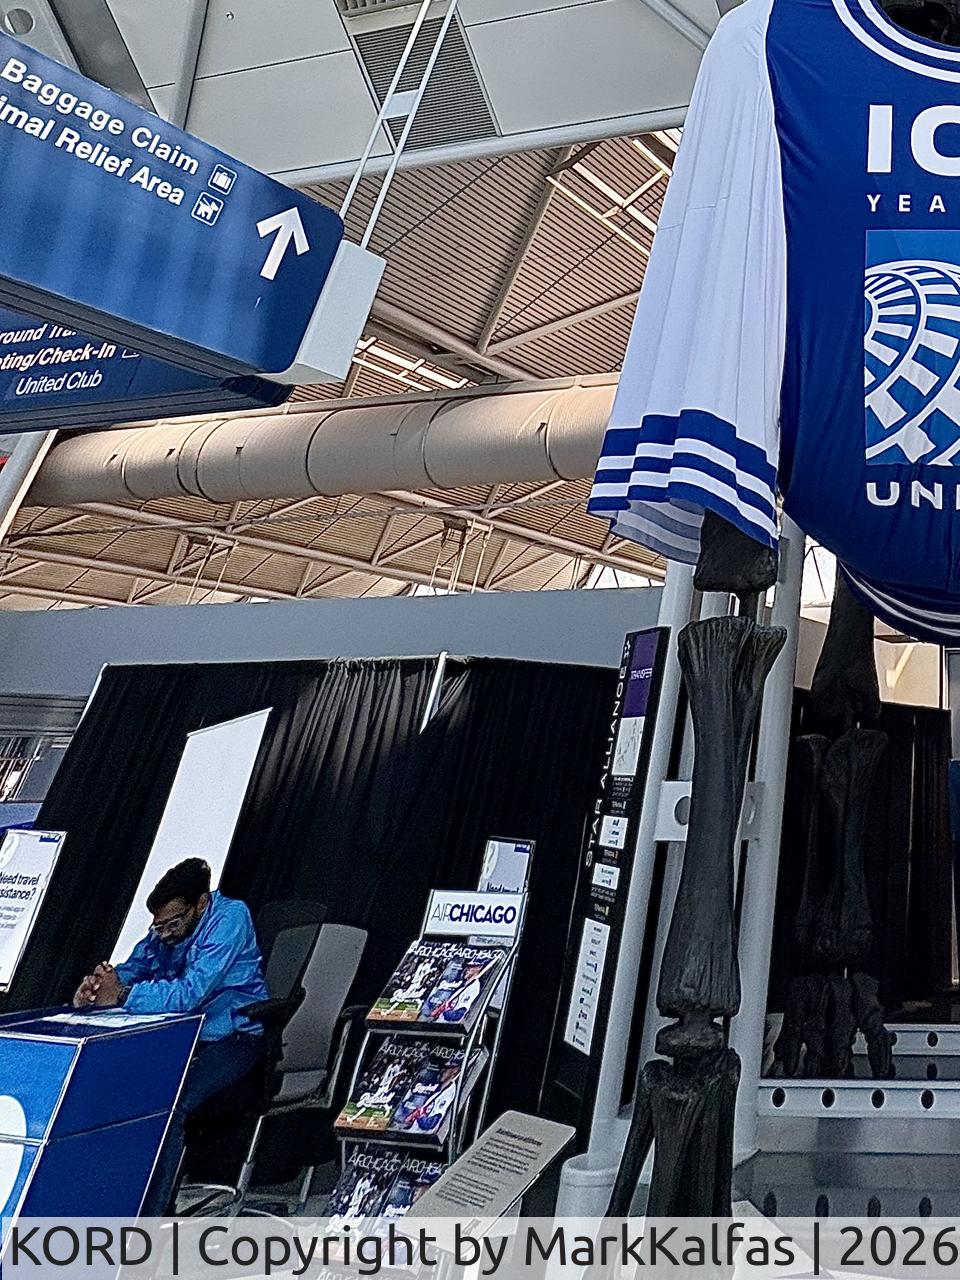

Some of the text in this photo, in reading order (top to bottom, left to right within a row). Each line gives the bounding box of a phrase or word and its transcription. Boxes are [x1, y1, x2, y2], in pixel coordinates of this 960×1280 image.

[1, 58, 199, 175] Baggage Claim
[0, 95, 186, 206] imal Relief Area
[0, 323, 49, 345] round
[15, 370, 104, 396] United Club
[585, 798, 603, 867] STAR
[0, 886, 37, 901] sistance?
[431, 903, 517, 925] AIRCHICAGO
